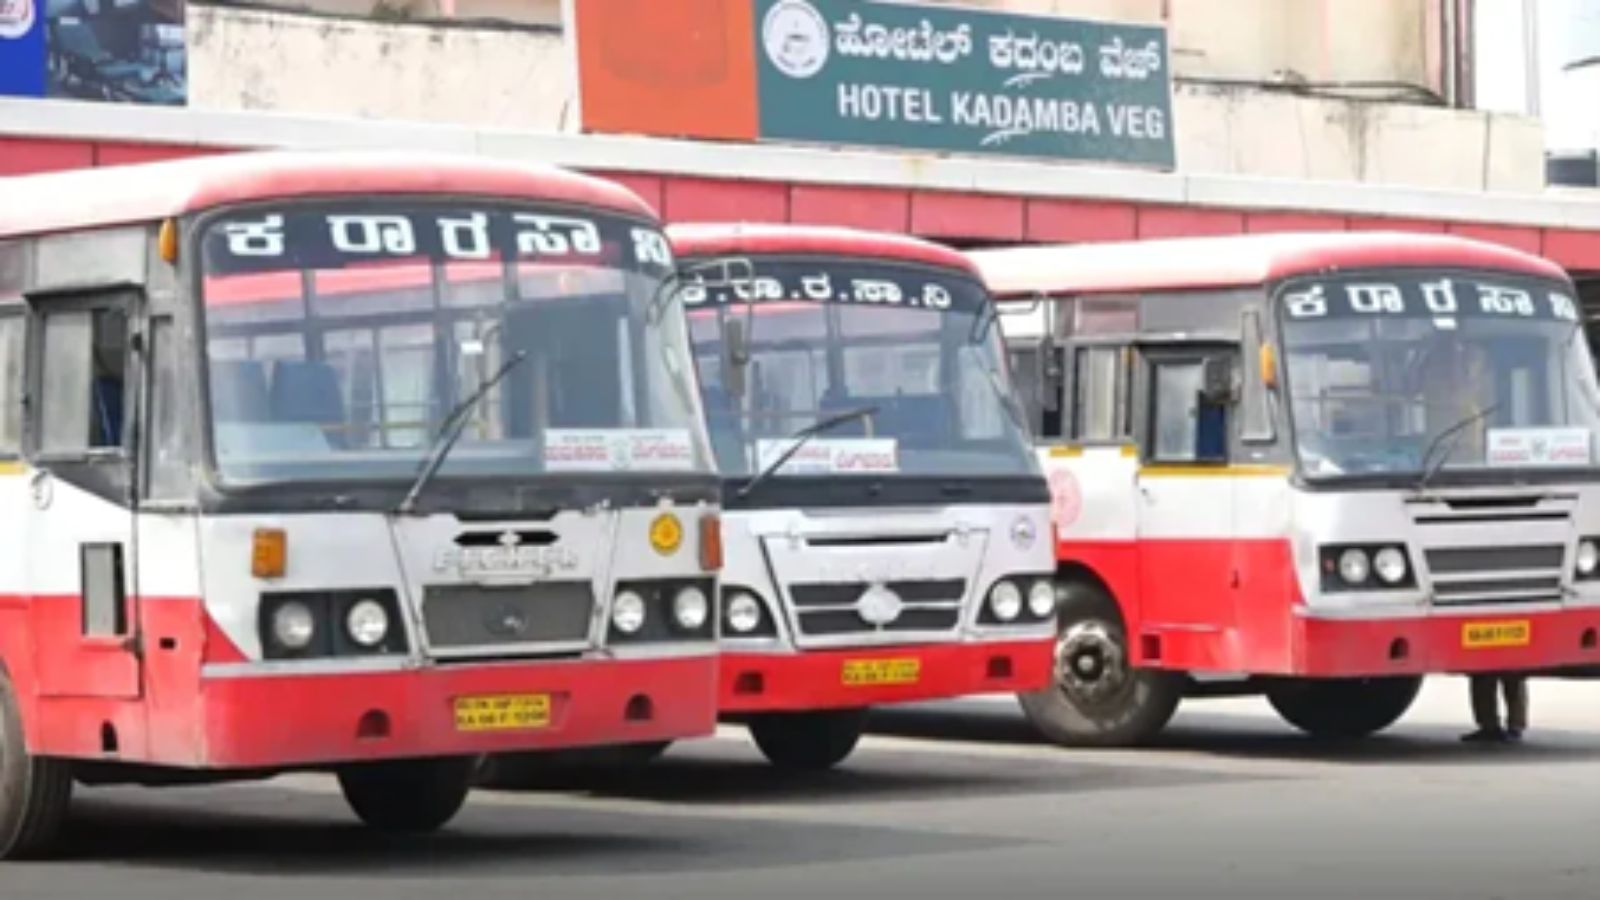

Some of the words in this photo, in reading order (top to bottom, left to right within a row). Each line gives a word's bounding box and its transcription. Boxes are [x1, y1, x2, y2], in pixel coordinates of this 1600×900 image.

[834, 13, 973, 64] ಹೋಟೆಲ್
[989, 29, 1083, 74] ಕದಂಬ
[1099, 36, 1161, 78] ವೆಜ್
[838, 83, 942, 122] HOTEL
[953, 91, 1100, 133] KADAMBA
[1107, 104, 1165, 139] VEG
